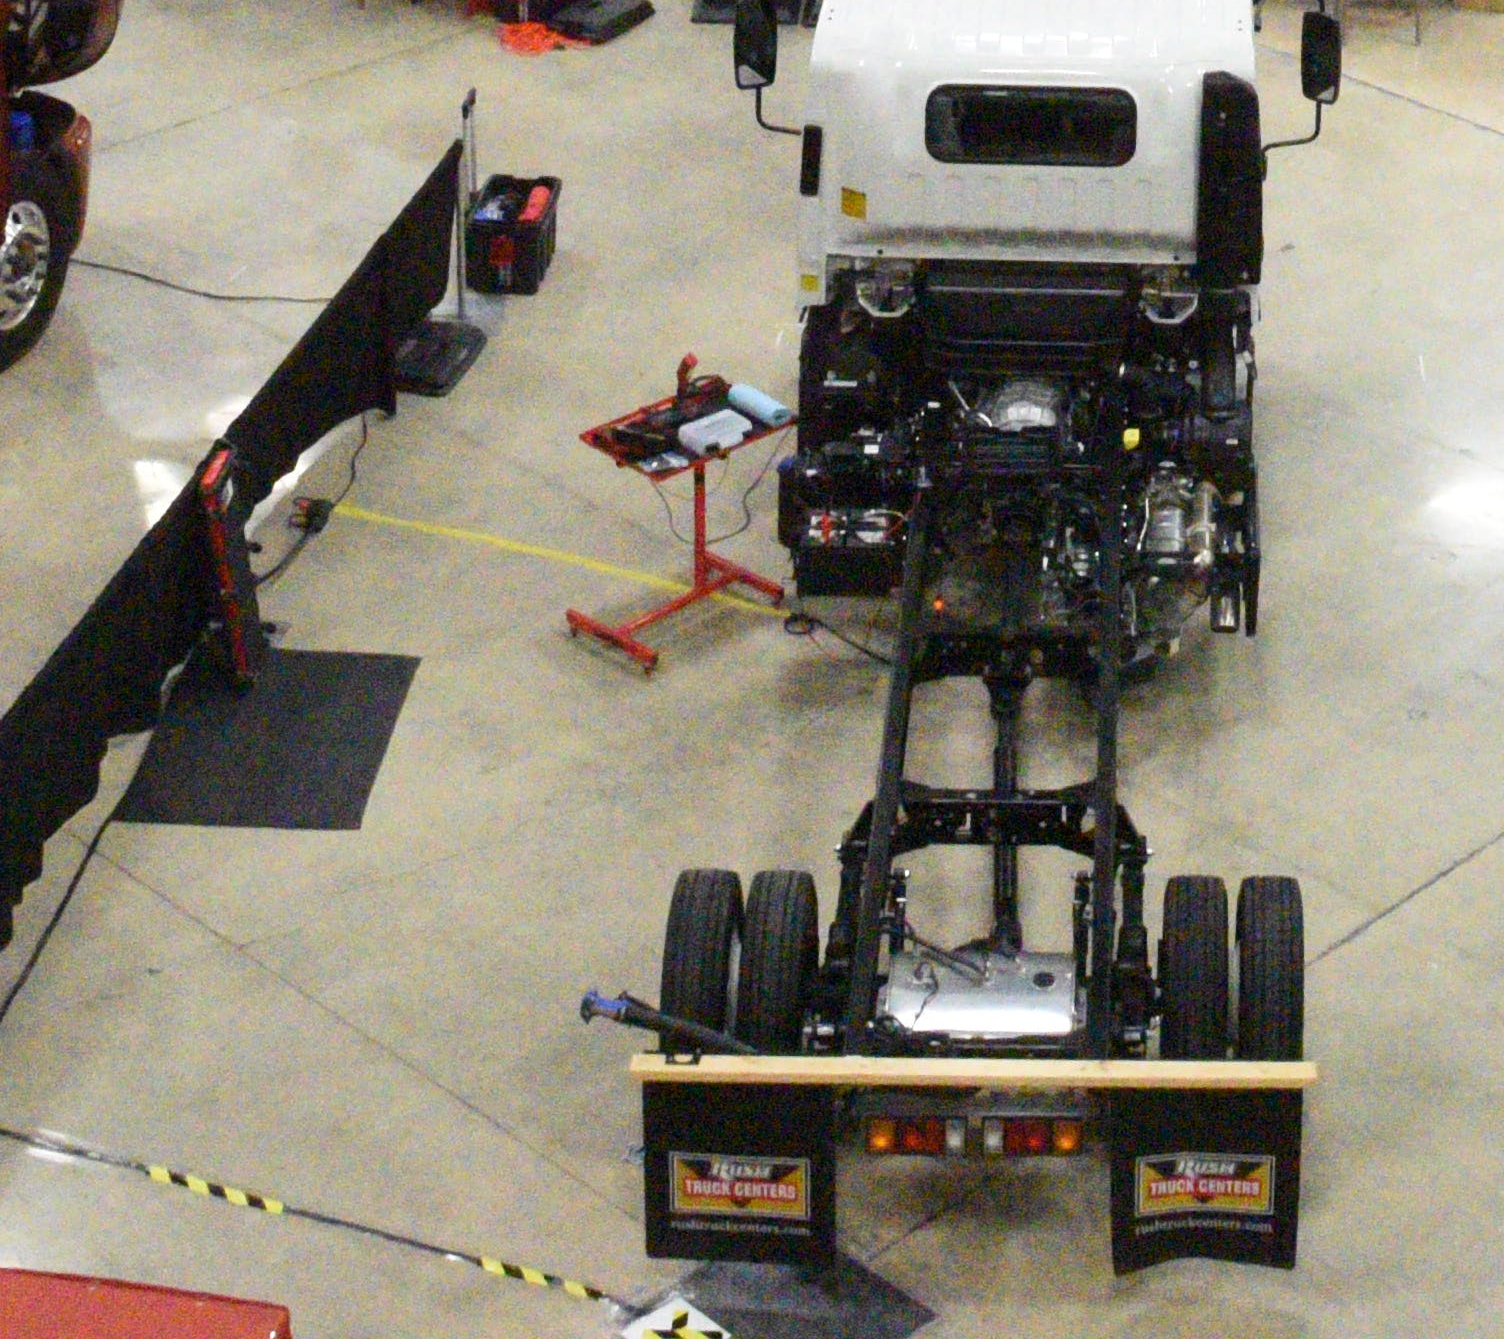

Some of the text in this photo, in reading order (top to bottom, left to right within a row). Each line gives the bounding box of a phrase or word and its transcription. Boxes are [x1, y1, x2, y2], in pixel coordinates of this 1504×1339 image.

[684, 1179, 797, 1200] TRUCK CENTERS
[1150, 1178, 1260, 1196] TRUCK CENTERS
